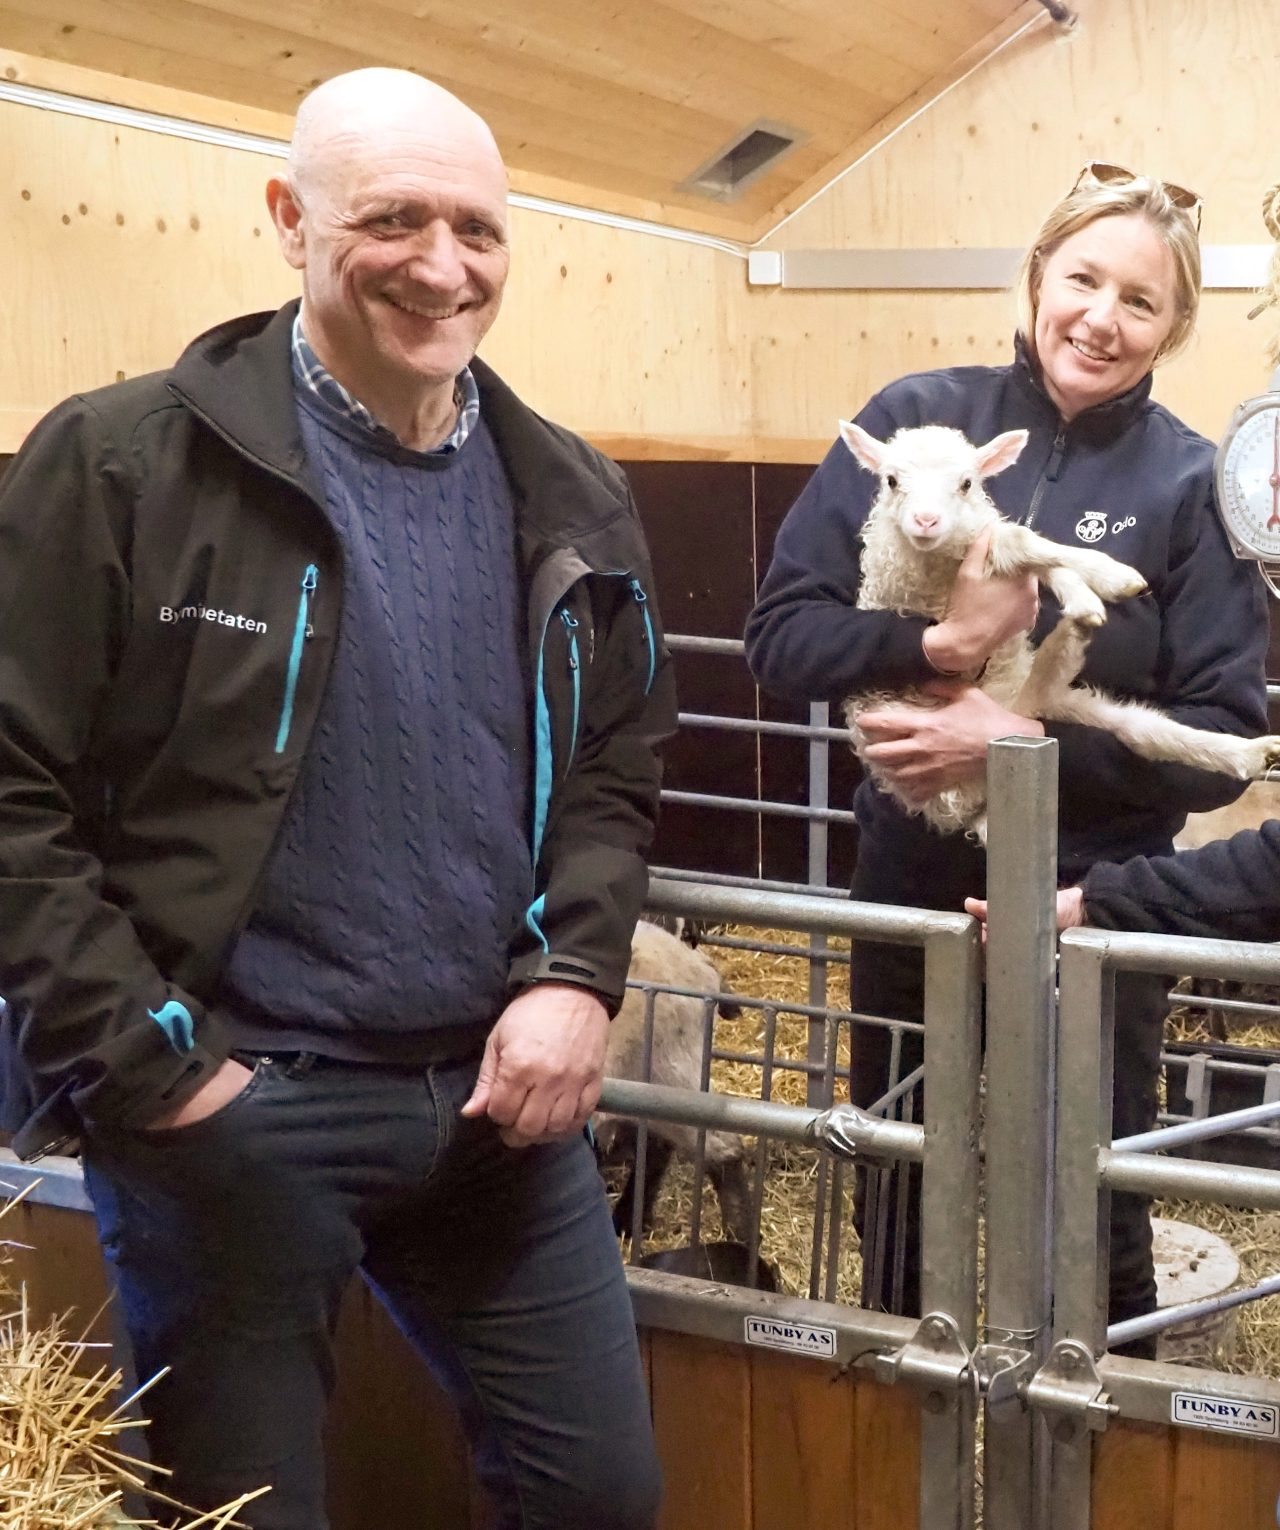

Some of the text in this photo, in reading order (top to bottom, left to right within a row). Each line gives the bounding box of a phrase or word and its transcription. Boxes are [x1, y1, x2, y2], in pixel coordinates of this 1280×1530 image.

[750, 1322, 803, 1339] TUNBY
[808, 1333, 830, 1344] AS
[1178, 1400, 1241, 1417] TUNBY
[1245, 1410, 1271, 1422] AS
